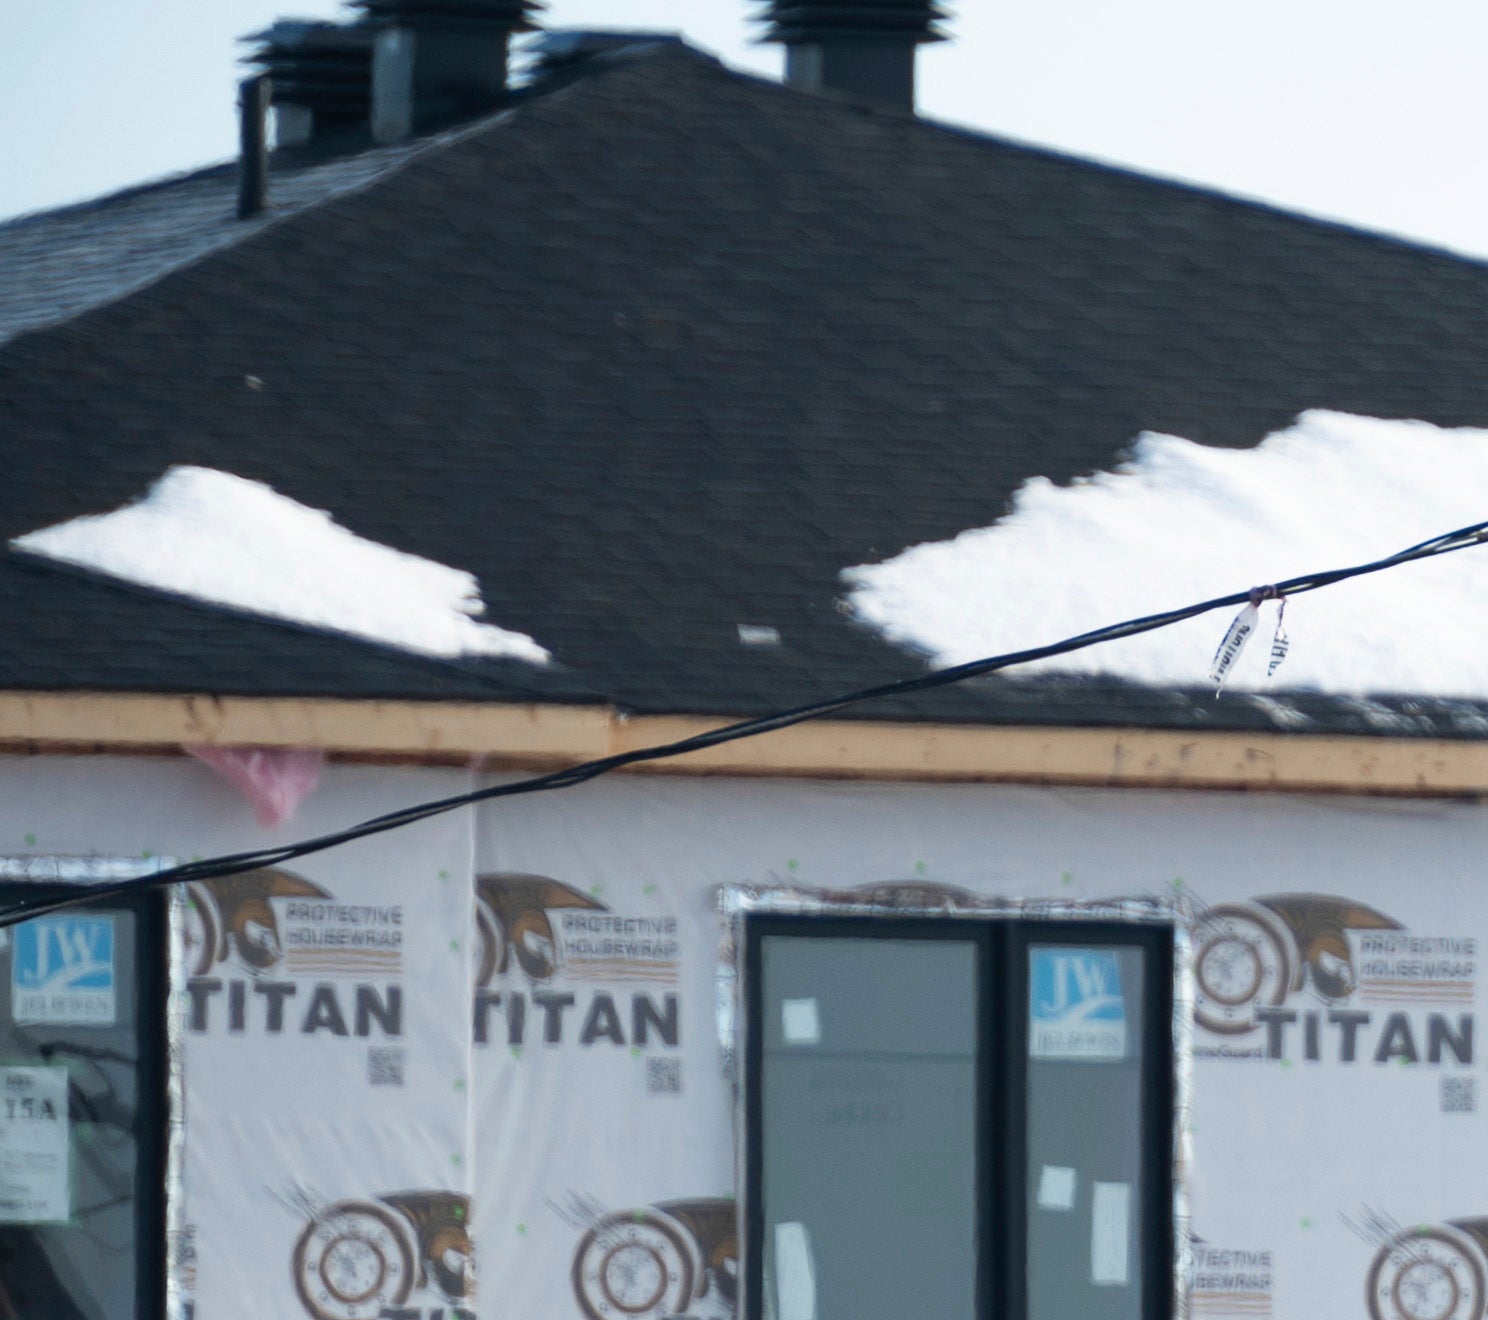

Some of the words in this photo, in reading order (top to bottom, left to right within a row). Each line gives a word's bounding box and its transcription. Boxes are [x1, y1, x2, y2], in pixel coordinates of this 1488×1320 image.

[186, 977, 402, 1036] TITAN
[473, 989, 679, 1046] TITAN
[1255, 1010, 1474, 1063] TITAN
